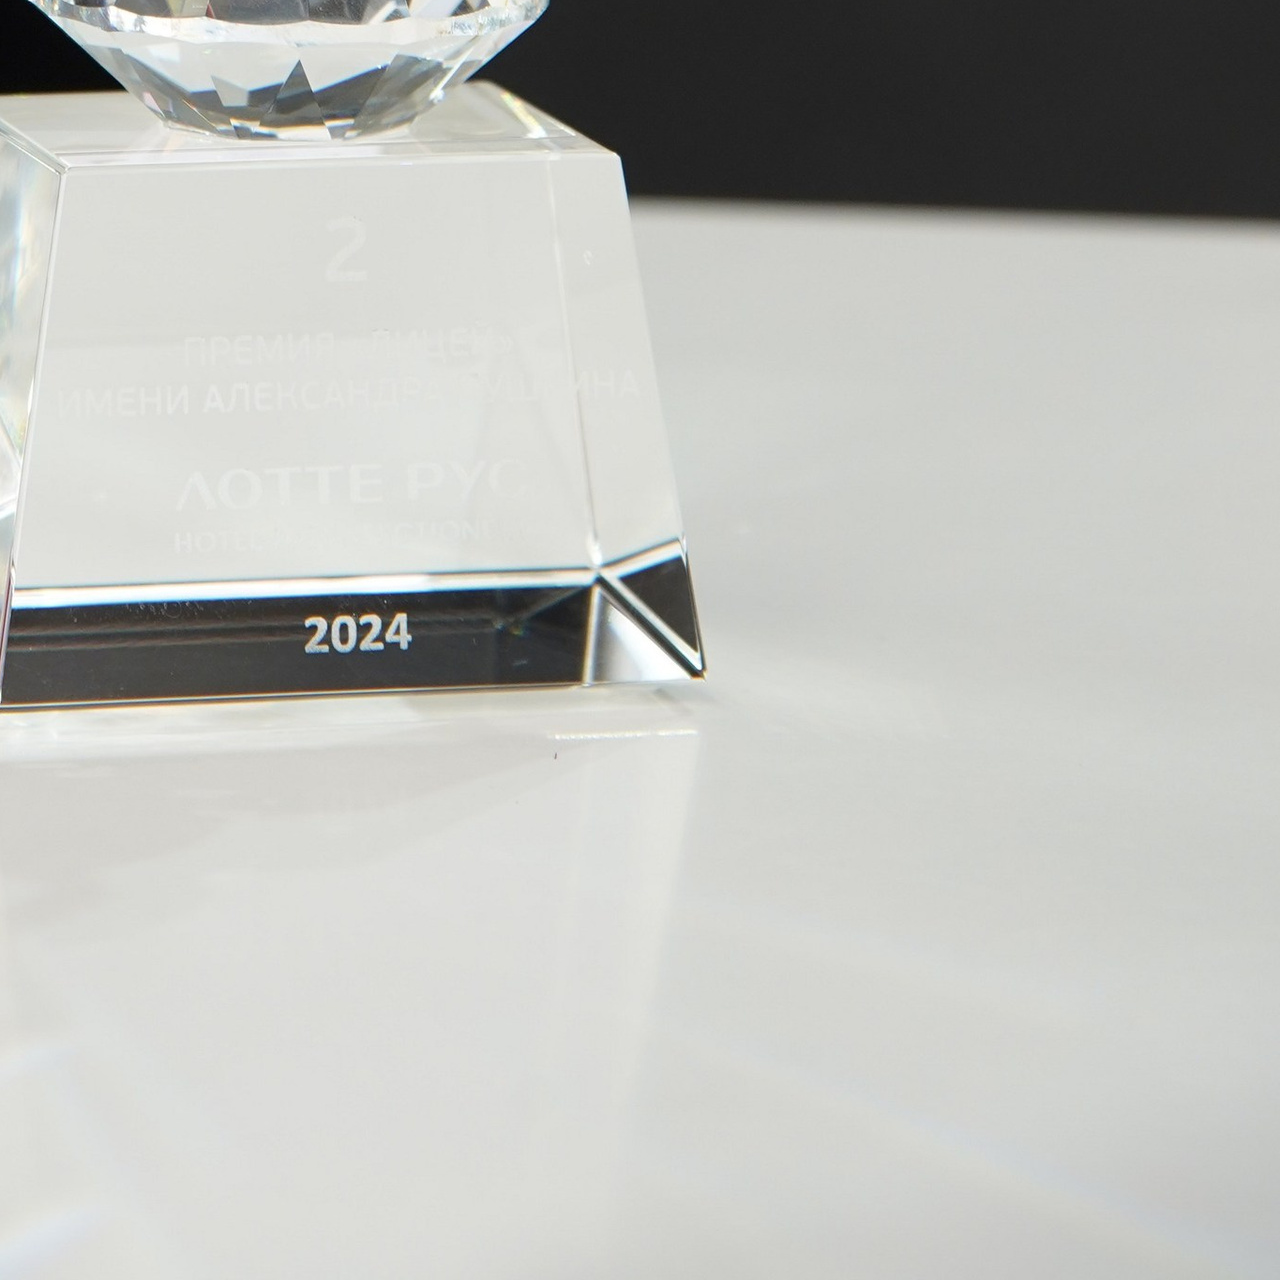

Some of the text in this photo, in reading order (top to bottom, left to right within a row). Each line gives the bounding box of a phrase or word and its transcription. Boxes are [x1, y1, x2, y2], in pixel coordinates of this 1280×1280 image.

[324, 216, 369, 283] 2
[183, 331, 336, 367] ПРЕМИЯ
[56, 382, 190, 419] ИМЕНИ
[406, 456, 530, 503] РУС
[303, 612, 414, 655] 2024
